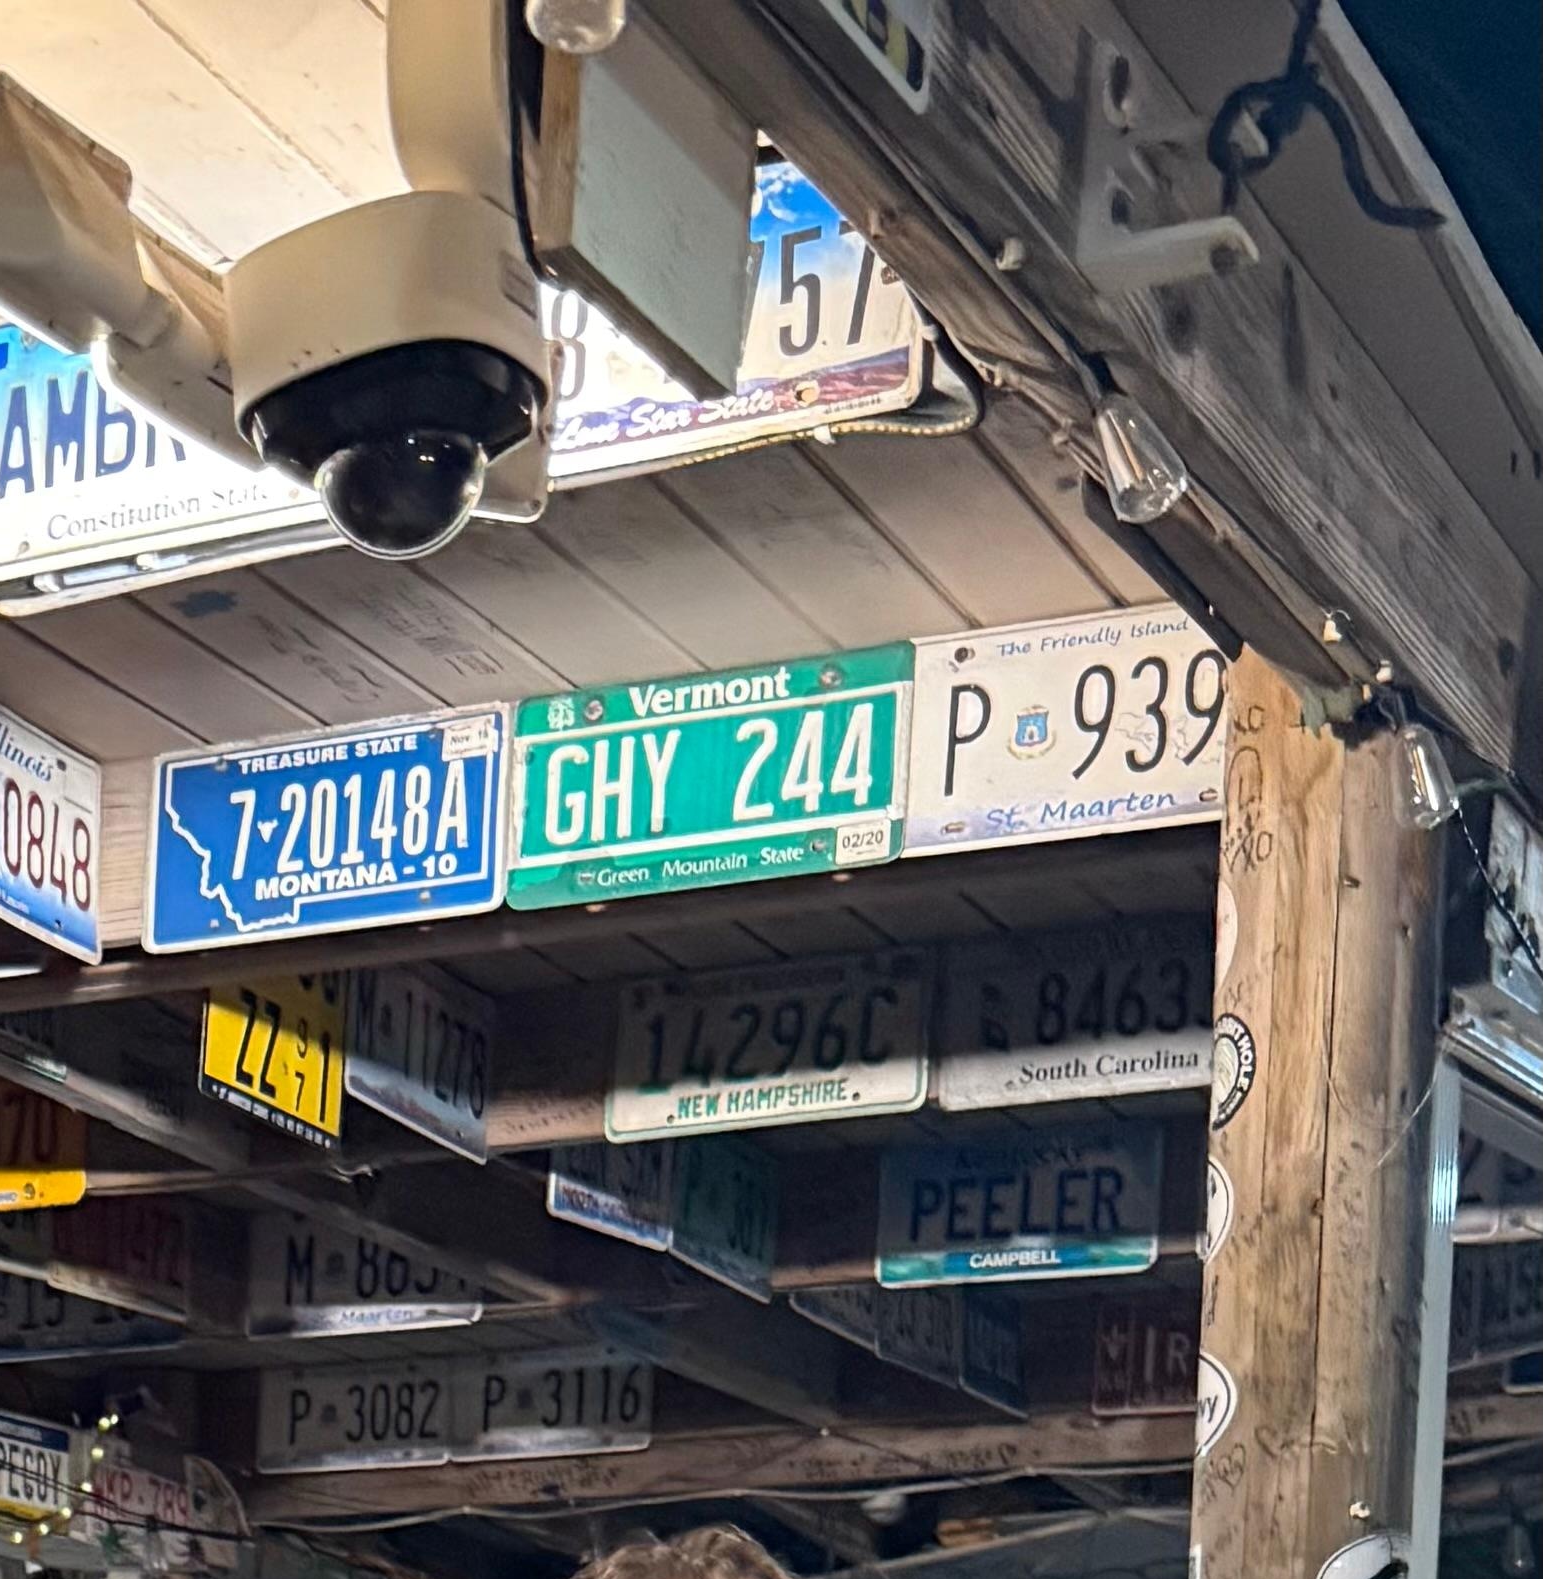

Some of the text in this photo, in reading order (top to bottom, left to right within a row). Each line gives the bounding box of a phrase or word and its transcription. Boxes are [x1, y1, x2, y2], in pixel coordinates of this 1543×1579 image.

[626, 402, 693, 438] Star
[48, 497, 200, 540] Constitution
[997, 617, 1189, 659] The Friendly Island
[628, 666, 790, 718] Vermont
[945, 649, 1228, 797] P 939
[239, 735, 418, 775] TREASURE STATE
[545, 702, 875, 846] GHY 244
[1040, 791, 1176, 823] Maarten
[4, 778, 91, 912] 0848
[841, 829, 885, 848] 02/20
[255, 862, 397, 901] MONTANA
[421, 853, 457, 879] 10
[598, 845, 804, 886] Green Mountain State
[1020, 1048, 1200, 1087] South Carolina
[677, 1075, 848, 1120] NEW HAMPSHIRE
[908, 1166, 1125, 1245] PEELER
[969, 1248, 1061, 1269] CAMPBELL
[289, 1365, 641, 1445] P 3082 P 3116
